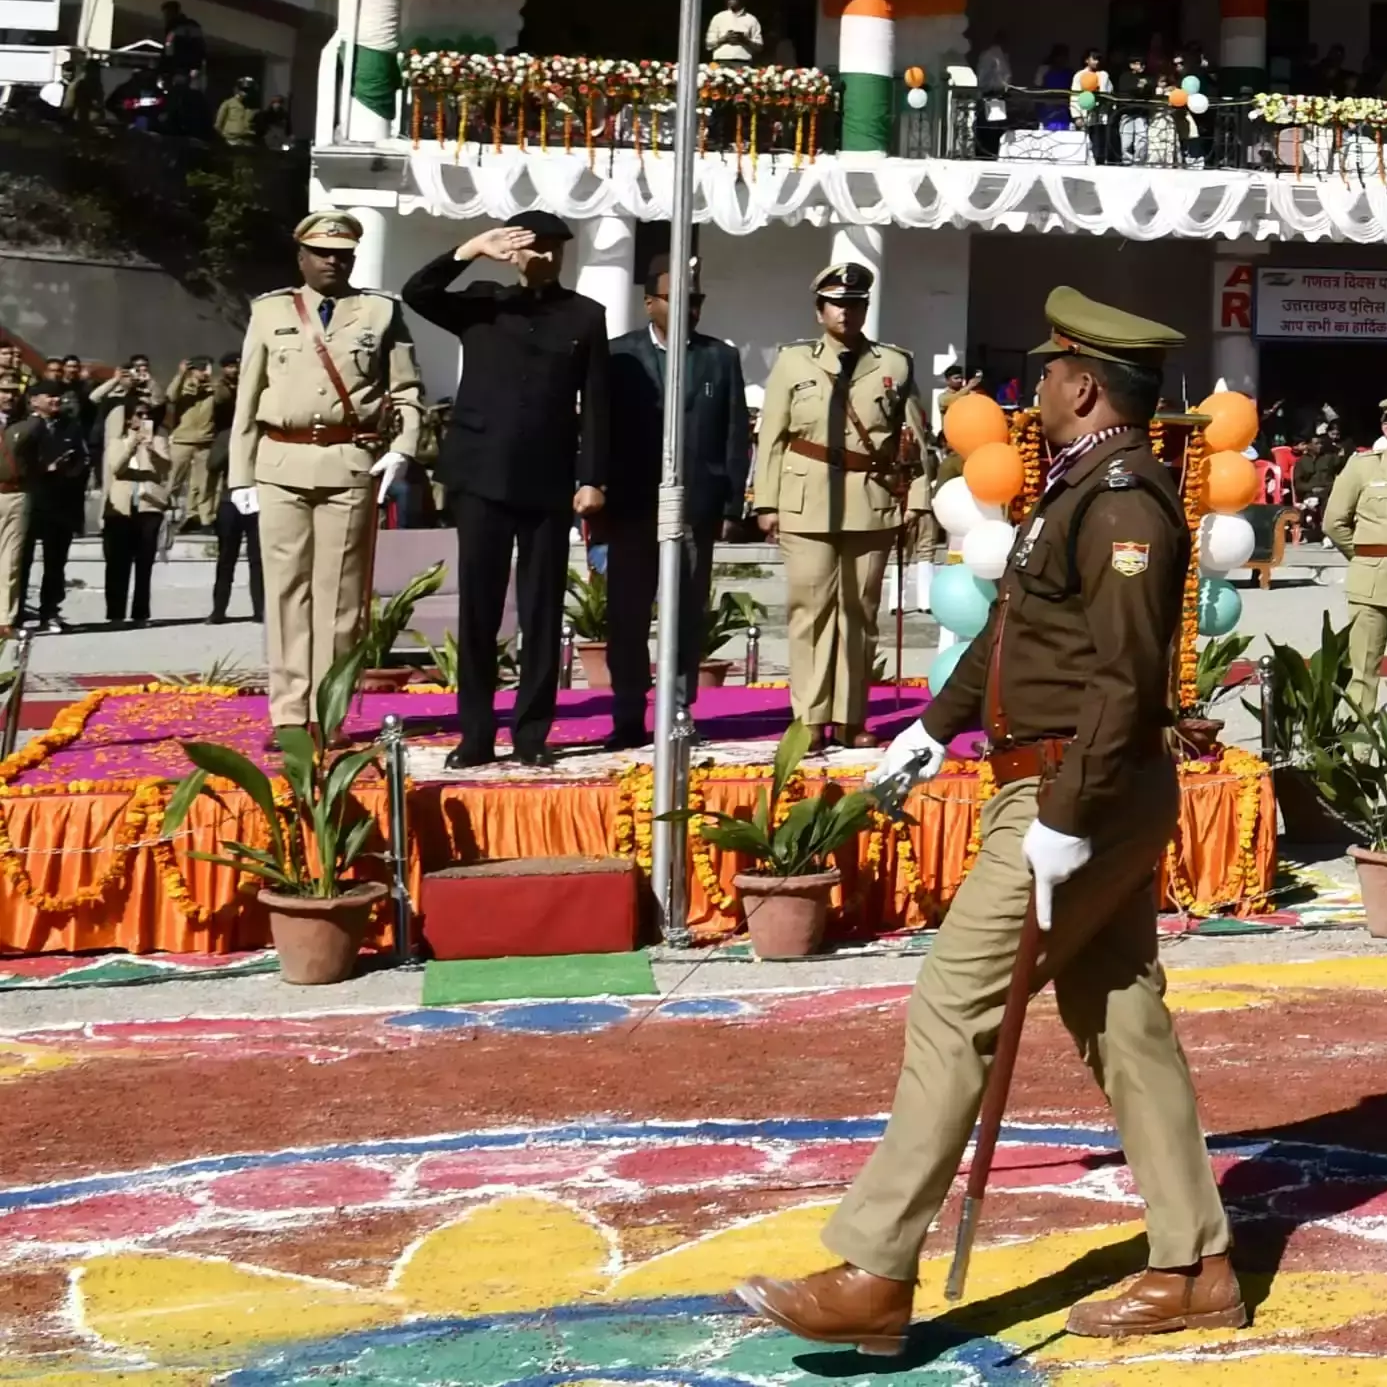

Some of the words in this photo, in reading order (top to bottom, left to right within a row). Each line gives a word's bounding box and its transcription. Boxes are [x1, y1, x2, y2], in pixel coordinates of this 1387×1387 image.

[1344, 271, 1377, 290] दिवस
[1281, 299, 1347, 314] उत्तराखण्ड
[1279, 320, 1304, 333] आप
[1306, 317, 1332, 333] सभी
[1334, 321, 1350, 333] का
[1352, 317, 1387, 334] हार्दिक
